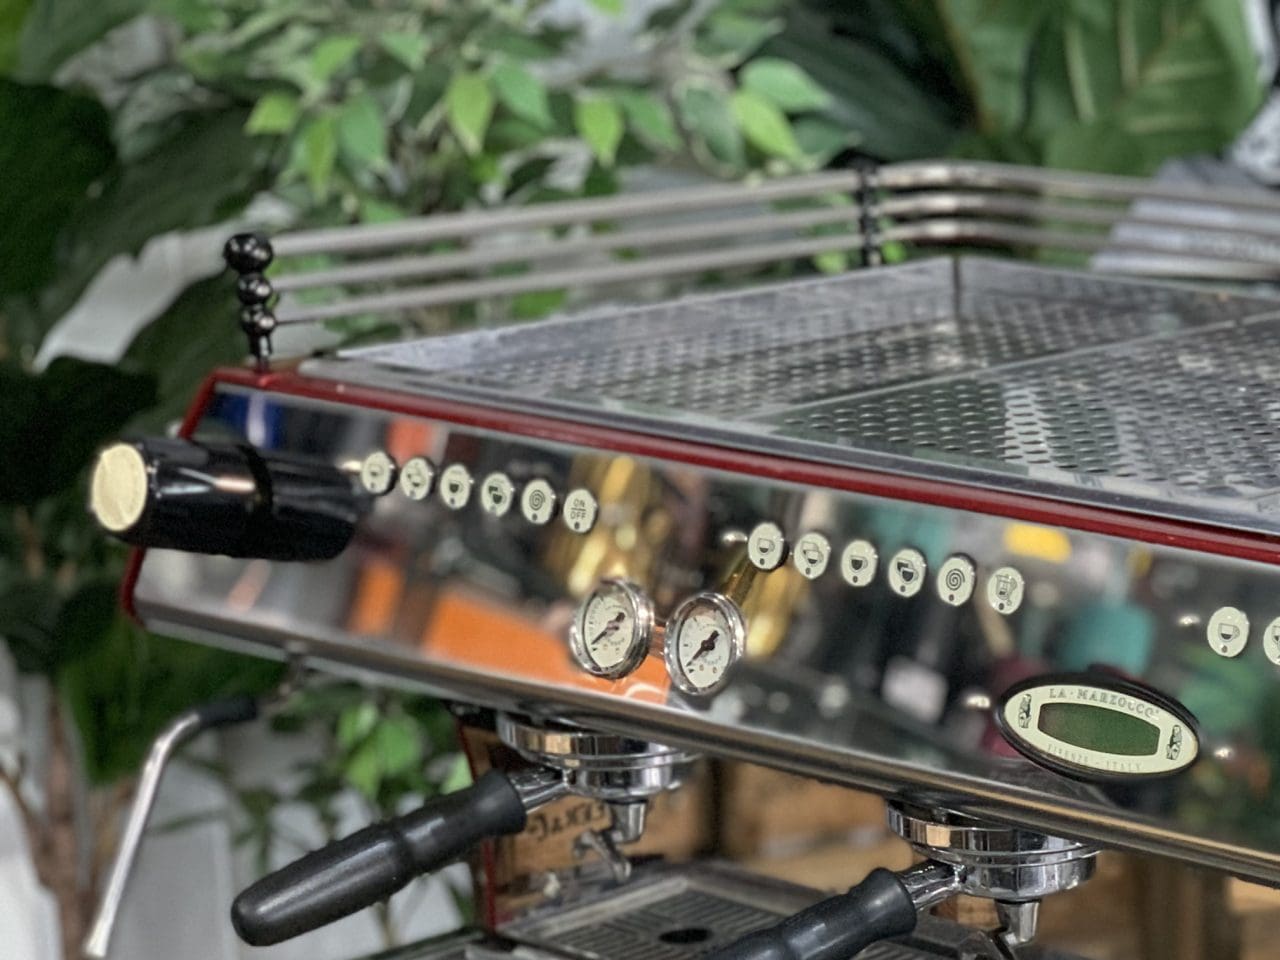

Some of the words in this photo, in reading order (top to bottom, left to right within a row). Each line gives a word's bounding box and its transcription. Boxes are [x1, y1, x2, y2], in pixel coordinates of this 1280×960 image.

[573, 497, 585, 508] ON
[570, 510, 587, 521] OFF
[1105, 759, 1143, 773] ITALY
